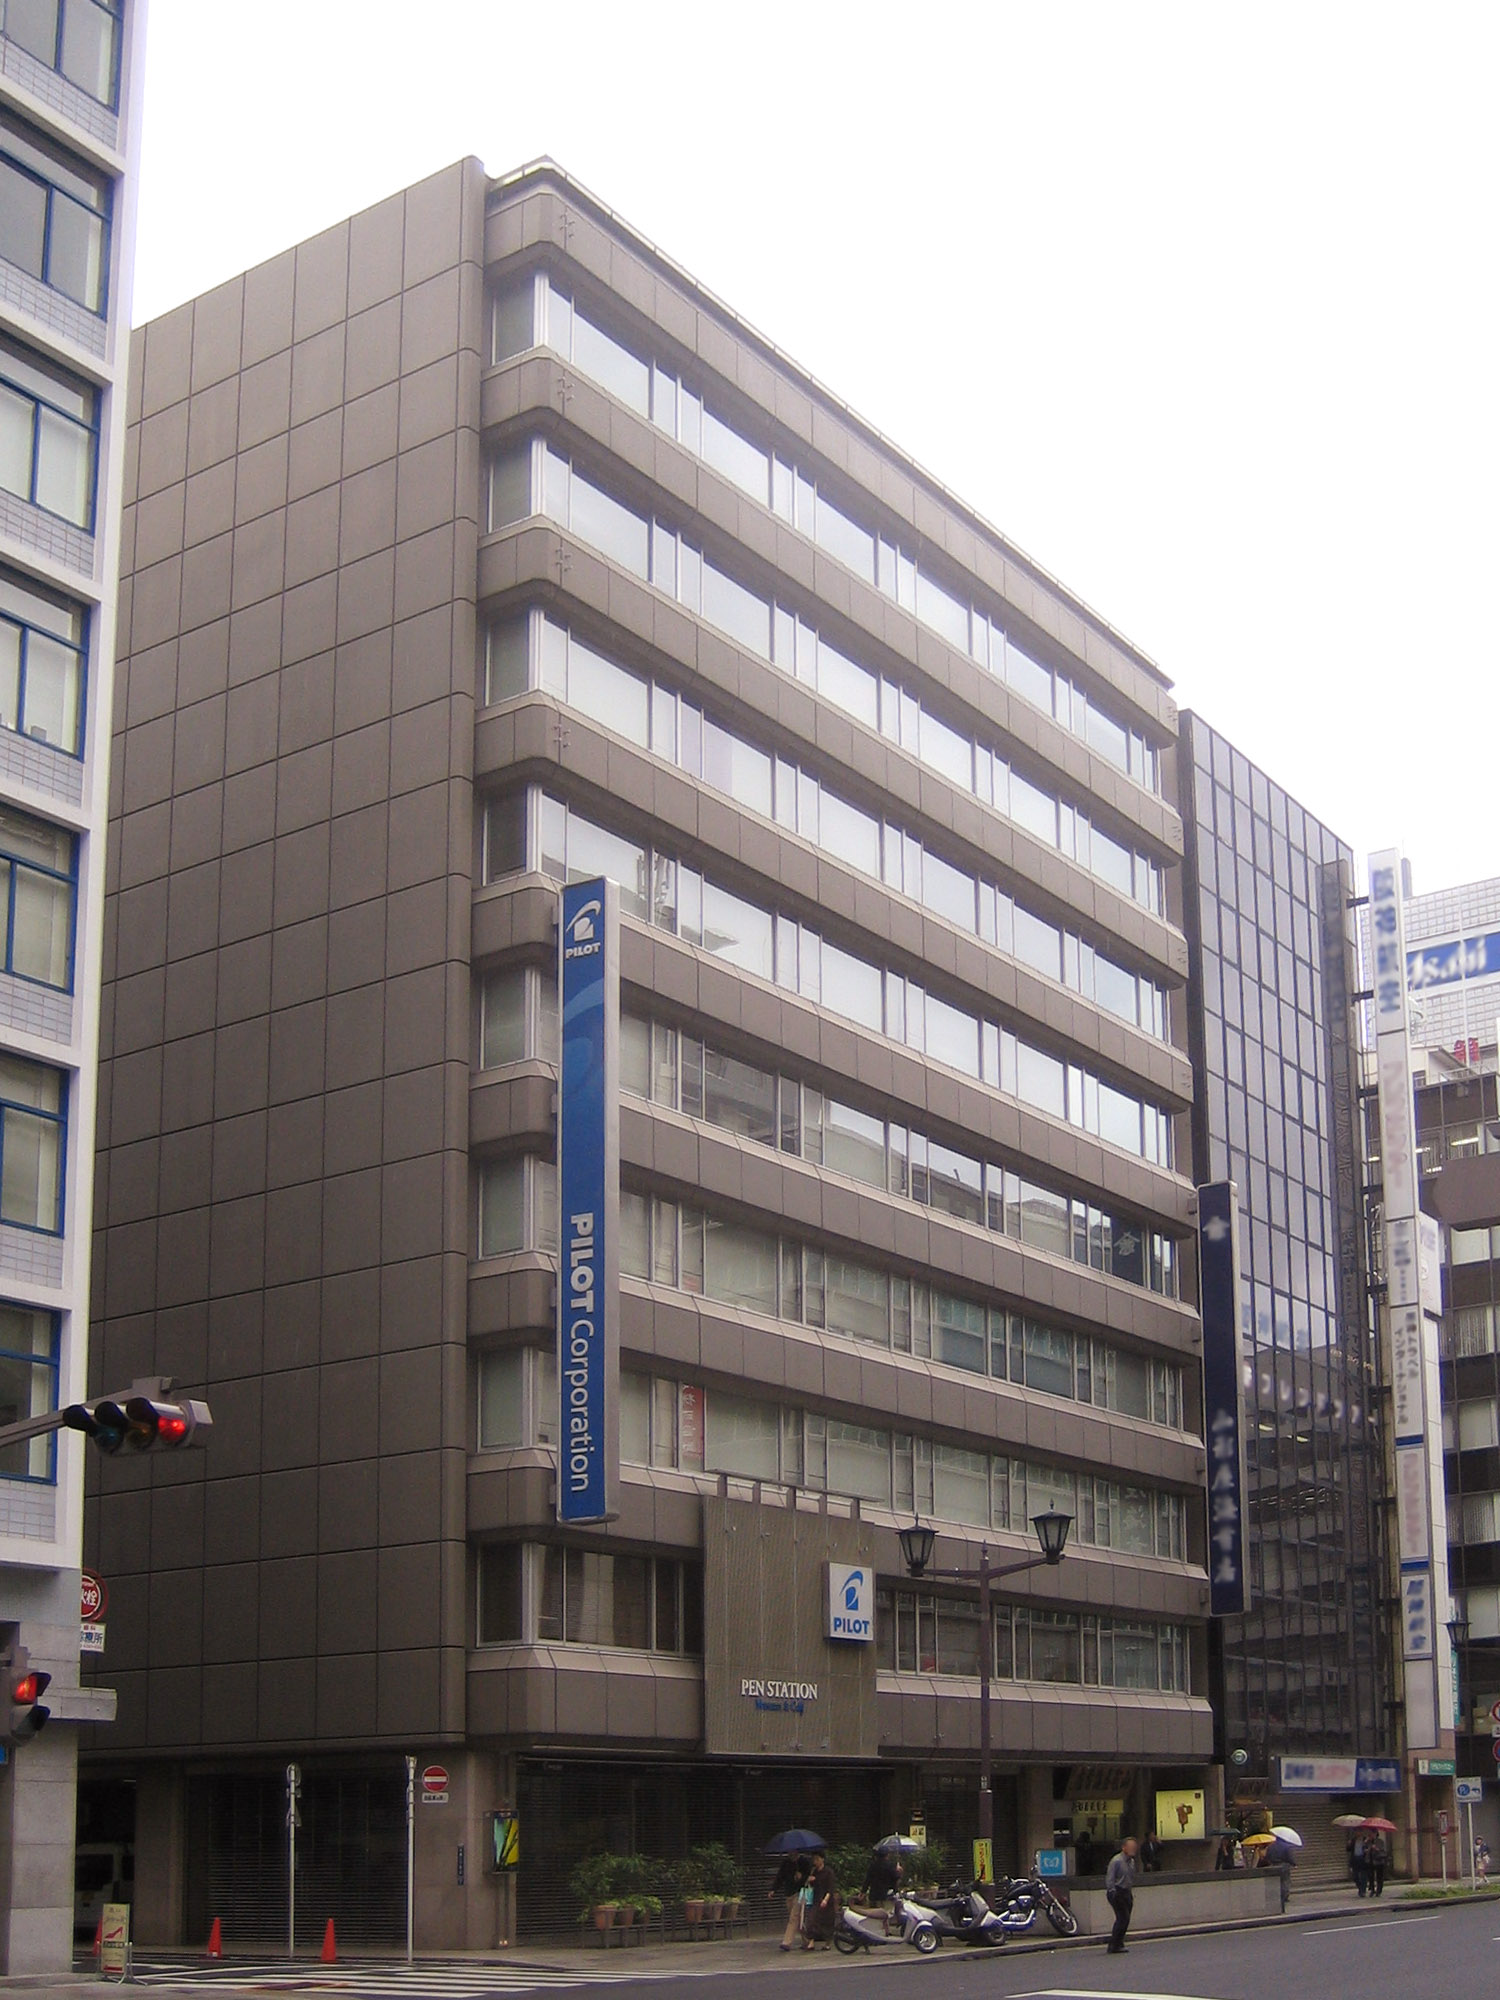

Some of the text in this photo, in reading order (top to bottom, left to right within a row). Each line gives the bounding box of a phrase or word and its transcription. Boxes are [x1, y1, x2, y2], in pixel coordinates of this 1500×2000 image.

[566, 942, 601, 959] PILOT
[564, 1212, 595, 1492] PILOT Corporation
[834, 1617, 869, 1634] PILOT
[741, 1679, 818, 1699] PEN STATION
